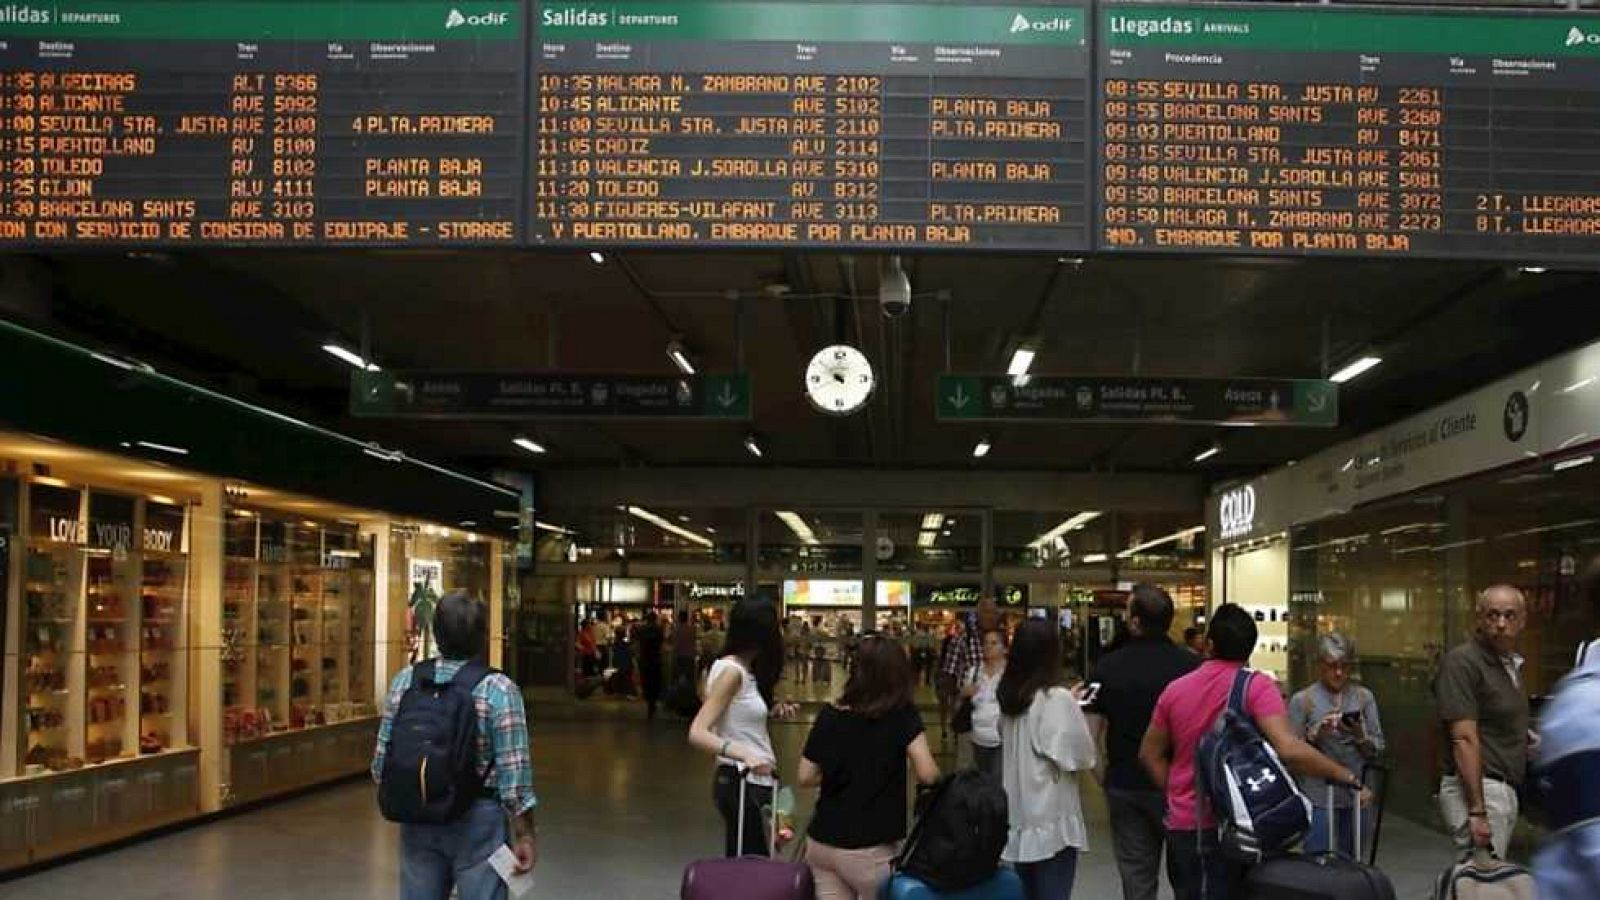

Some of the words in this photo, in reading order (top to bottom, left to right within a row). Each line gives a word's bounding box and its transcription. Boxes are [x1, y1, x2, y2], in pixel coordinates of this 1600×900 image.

[61, 14, 120, 24] DEPARTURES
[467, 12, 509, 26] adif
[543, 8, 607, 26] Salidas
[619, 15, 679, 25] DEPARTURES
[1032, 17, 1073, 32] adif
[1110, 16, 1192, 36] Llegadas
[1204, 22, 1250, 33] ARRIVALS
[1165, 52, 1224, 64] Procedencia
[233, 75, 265, 91] ALT
[540, 75, 591, 91] 10:35
[597, 76, 661, 92] MALAGA
[671, 76, 691, 92] M.
[703, 76, 788, 92] ZAMBRANO
[794, 77, 826, 92] AVE
[836, 77, 880, 92] 2102
[1106, 80, 1160, 97] 08:55
[1164, 82, 1239, 100] SEVILLA
[1250, 84, 1288, 100] STA.
[1301, 85, 1353, 102] JUSTA
[1358, 86, 1378, 102] AV
[1399, 88, 1441, 105] 2261
[39, 95, 124, 112] ALICANTE
[233, 96, 264, 112] AVE
[273, 96, 317, 112] 5092
[540, 96, 592, 112] 10:45
[596, 96, 682, 112] ALICANTE
[794, 98, 826, 114] AVE
[836, 98, 880, 114] 5102
[932, 100, 997, 116] PLANTA
[1006, 100, 1050, 116] BAJA
[1106, 102, 1160, 118] 08:55
[1164, 102, 1260, 120] BARCELONA
[1269, 106, 1322, 122] SANTS
[1358, 108, 1388, 124] AVE
[1400, 109, 1442, 126] 3260
[39, 116, 112, 132] SEVILLA
[123, 116, 163, 132] STA.
[175, 116, 228, 132] JUSTA
[233, 117, 263, 133] AVE
[273, 117, 316, 133] 2100
[352, 117, 362, 133] 4
[367, 116, 494, 133] PLTA.PRIMERA
[538, 117, 591, 133] 11:00
[596, 118, 670, 133] SEVILLA
[680, 118, 721, 133] STA.
[735, 118, 788, 133] JUSTA
[793, 118, 825, 134] AVE
[836, 118, 880, 134] 2110
[932, 121, 1061, 138] PLTA.PRIMERA
[1106, 123, 1160, 140] 09:03
[1164, 124, 1280, 142] PUERTOLLANO
[1358, 128, 1378, 144] AV
[1400, 130, 1441, 146] 8471
[40, 137, 155, 154] PUERTOLLANO
[232, 138, 254, 154] AV
[273, 138, 316, 154] 8100
[538, 138, 590, 154] 11:05
[596, 138, 649, 154] CADIZ
[792, 140, 825, 156] ALV
[836, 140, 878, 156] 2114
[1106, 144, 1160, 160] 09:15
[1164, 145, 1238, 160] SEVILLA
[1249, 146, 1288, 163] STA.
[1301, 148, 1352, 164] JUSTA
[1358, 150, 1389, 166] AVE
[1400, 152, 1441, 168] 2061
[41, 158, 103, 174] TOLEDO
[232, 159, 253, 175] AV
[273, 159, 315, 175] 8102
[366, 158, 430, 175] PLANTA
[439, 158, 483, 175] BAJA
[538, 160, 590, 176] 11:10
[596, 160, 680, 176] VALENCIA
[692, 160, 788, 176] J.SOROLLA
[792, 161, 825, 177] AVE
[835, 161, 878, 177] 5310
[932, 163, 996, 180] PLANTA
[1006, 163, 1050, 180] BAJA
[1106, 165, 1160, 182] 09:48
[1164, 167, 1248, 184] VALENCIA
[1259, 169, 1352, 186] J.SOROLLA
[1358, 171, 1389, 187] AVE
[1400, 172, 1441, 189] 5081
[40, 180, 92, 196] GIJON
[232, 180, 263, 196] ALV
[272, 180, 315, 196] 4111
[366, 180, 430, 196] PLANTA
[438, 180, 482, 196] BAJA
[537, 181, 590, 196] 11:20
[596, 181, 659, 196] TOLEDO
[792, 182, 814, 198] AV
[835, 182, 878, 198] 8312
[1106, 186, 1160, 203] 09:50
[1164, 188, 1260, 204] BARCELONA
[1268, 190, 1322, 206] SANTS
[1358, 192, 1389, 208] AVE
[1400, 194, 1442, 210] 3072
[1476, 196, 1488, 211] 2
[1494, 196, 1512, 212] T.
[39, 201, 134, 217] BARCELONA
[143, 201, 196, 217] SANTS
[231, 202, 262, 218] AVE
[272, 202, 314, 218] 3103
[536, 202, 590, 218] 11:30
[594, 202, 774, 218] FIGUERES-VILAFANT
[792, 203, 824, 219] AVE
[835, 203, 878, 219] 3113
[931, 204, 1060, 222] PLTA.PRIMERA
[1106, 208, 1160, 224] 09:50
[1164, 208, 1227, 226] MALAGA
[1238, 210, 1256, 226] M.
[1269, 212, 1353, 228] ZAMBRANO
[1358, 213, 1389, 229] AVE
[1400, 214, 1441, 230] 2273
[1476, 216, 1488, 232] 8
[1494, 217, 1512, 233] T.
[36, 221, 67, 238] CON
[77, 222, 160, 239] SERVICIO
[170, 222, 191, 239] DE
[200, 222, 285, 239] CONSIGNA
[294, 222, 315, 239] DE
[324, 222, 408, 239] EQUIPAJE
[438, 222, 514, 239] STORAGE
[552, 224, 564, 240] Y
[573, 224, 700, 240] PUERTOLLANO.
[711, 224, 798, 240] EMBARQUE
[808, 224, 841, 241] POR
[851, 224, 916, 241] PLANTA
[926, 226, 970, 242] BAJA
[1155, 228, 1241, 246] EMBARQUE
[1252, 231, 1282, 248] POR
[1292, 232, 1358, 250] PLANTA
[1366, 234, 1410, 250] BAJA
[1440, 412, 1476, 439] Cliente
[96, 523, 132, 548] YOUR
[144, 528, 173, 552] BODY
